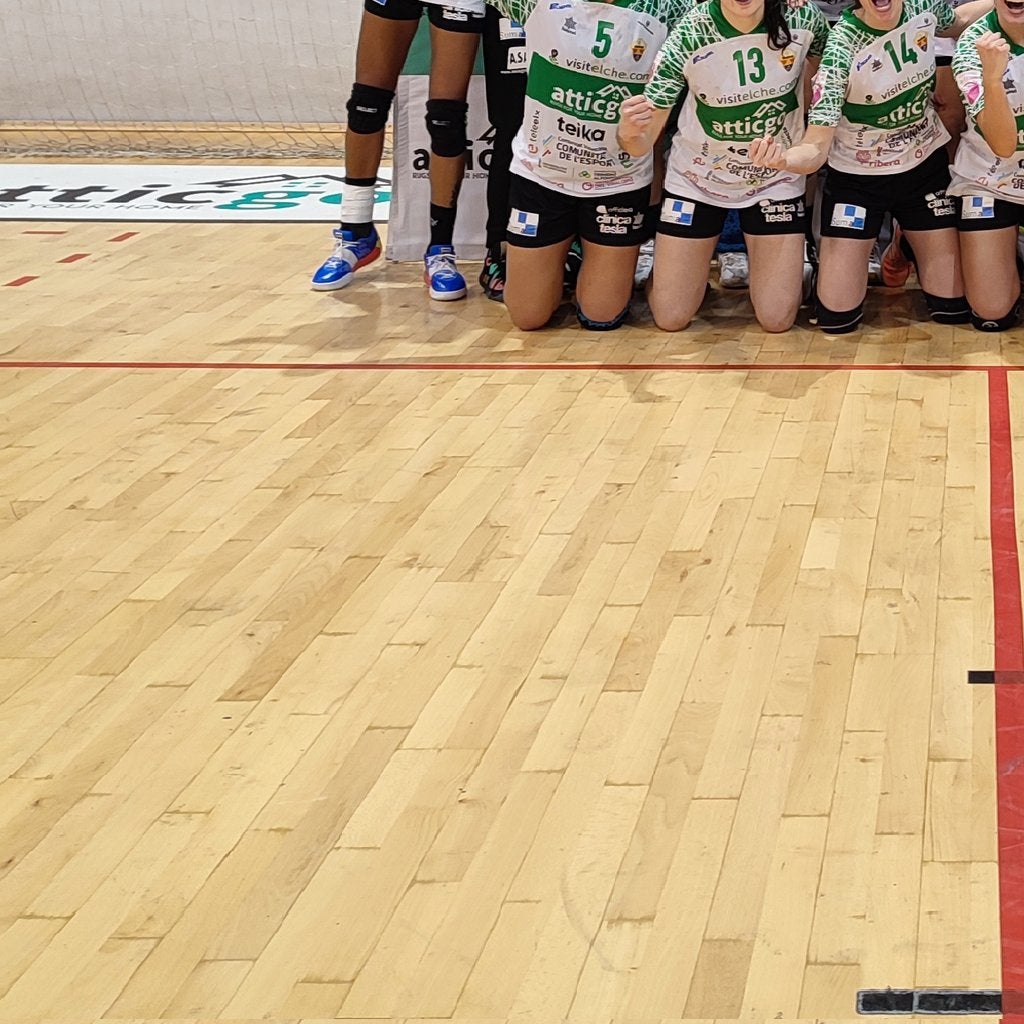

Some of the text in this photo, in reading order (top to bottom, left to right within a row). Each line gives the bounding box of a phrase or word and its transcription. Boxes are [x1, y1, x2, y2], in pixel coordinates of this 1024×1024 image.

[591, 20, 614, 59] 5
[510, 51, 527, 64] A.S
[883, 32, 918, 74] 14
[565, 57, 651, 80] visitelche.com
[732, 47, 766, 87] 13
[716, 78, 798, 105] visitelche.com
[881, 62, 936, 100] visitelche.c
[711, 111, 785, 137] atticgo
[877, 98, 928, 124] attic
[556, 116, 606, 142] teika
[559, 152, 572, 161] DE
[868, 159, 901, 168] ribera
[0, 184, 391, 211] tticgo
[766, 212, 793, 223] tesla
[933, 206, 956, 217] tesl
